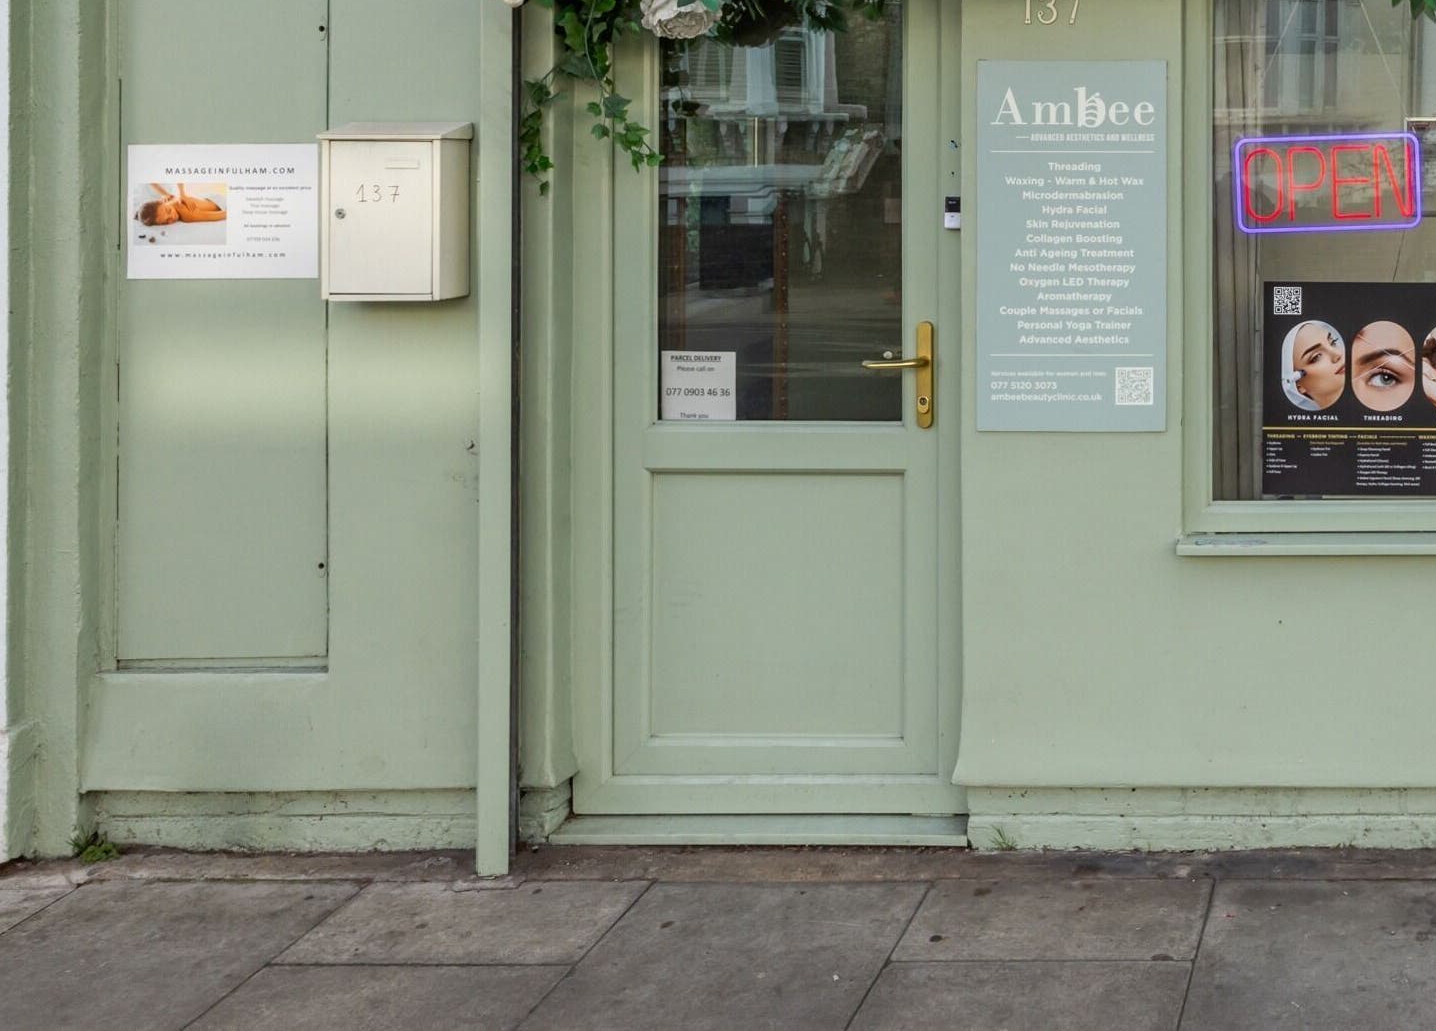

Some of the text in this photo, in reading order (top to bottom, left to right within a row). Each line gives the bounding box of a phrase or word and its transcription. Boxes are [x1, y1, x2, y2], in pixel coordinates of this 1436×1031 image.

[990, 86, 1155, 128] Ambee
[165, 167, 296, 176] MASSAGEINFULHAM.COM
[1048, 162, 1101, 172] Threading
[1005, 177, 1044, 186] Waxing
[1055, 177, 1086, 185] Warm
[1100, 177, 1117, 185] Hot
[1122, 177, 1144, 185] Wax
[1244, 144, 1417, 223] OPEN
[356, 184, 400, 203] 137
[1023, 192, 1123, 200] Microdermabrasion
[1042, 206, 1106, 215] Hydra Facial
[1026, 220, 1120, 230] Skin Rejuvenation
[1026, 235, 1122, 244] Collagen Boosting
[1015, 249, 1134, 259] Anti Ageing Treatment
[1010, 263, 1135, 273] No Needle Mesotherapy
[1019, 278, 1129, 288] Oxygen LED Therapy
[1037, 292, 1112, 302] Aromatherapy
[1000, 306, 1036, 316] Couple
[1040, 307, 1089, 316] Massages
[1107, 306, 1143, 315] Facials
[1017, 321, 1131, 331] Personal Yoga Trainer
[1019, 336, 1129, 344] Advanced Aesthetics
[991, 381, 1009, 389] 077
[666, 388, 682, 396] 077
[684, 388, 705, 396] 0903
